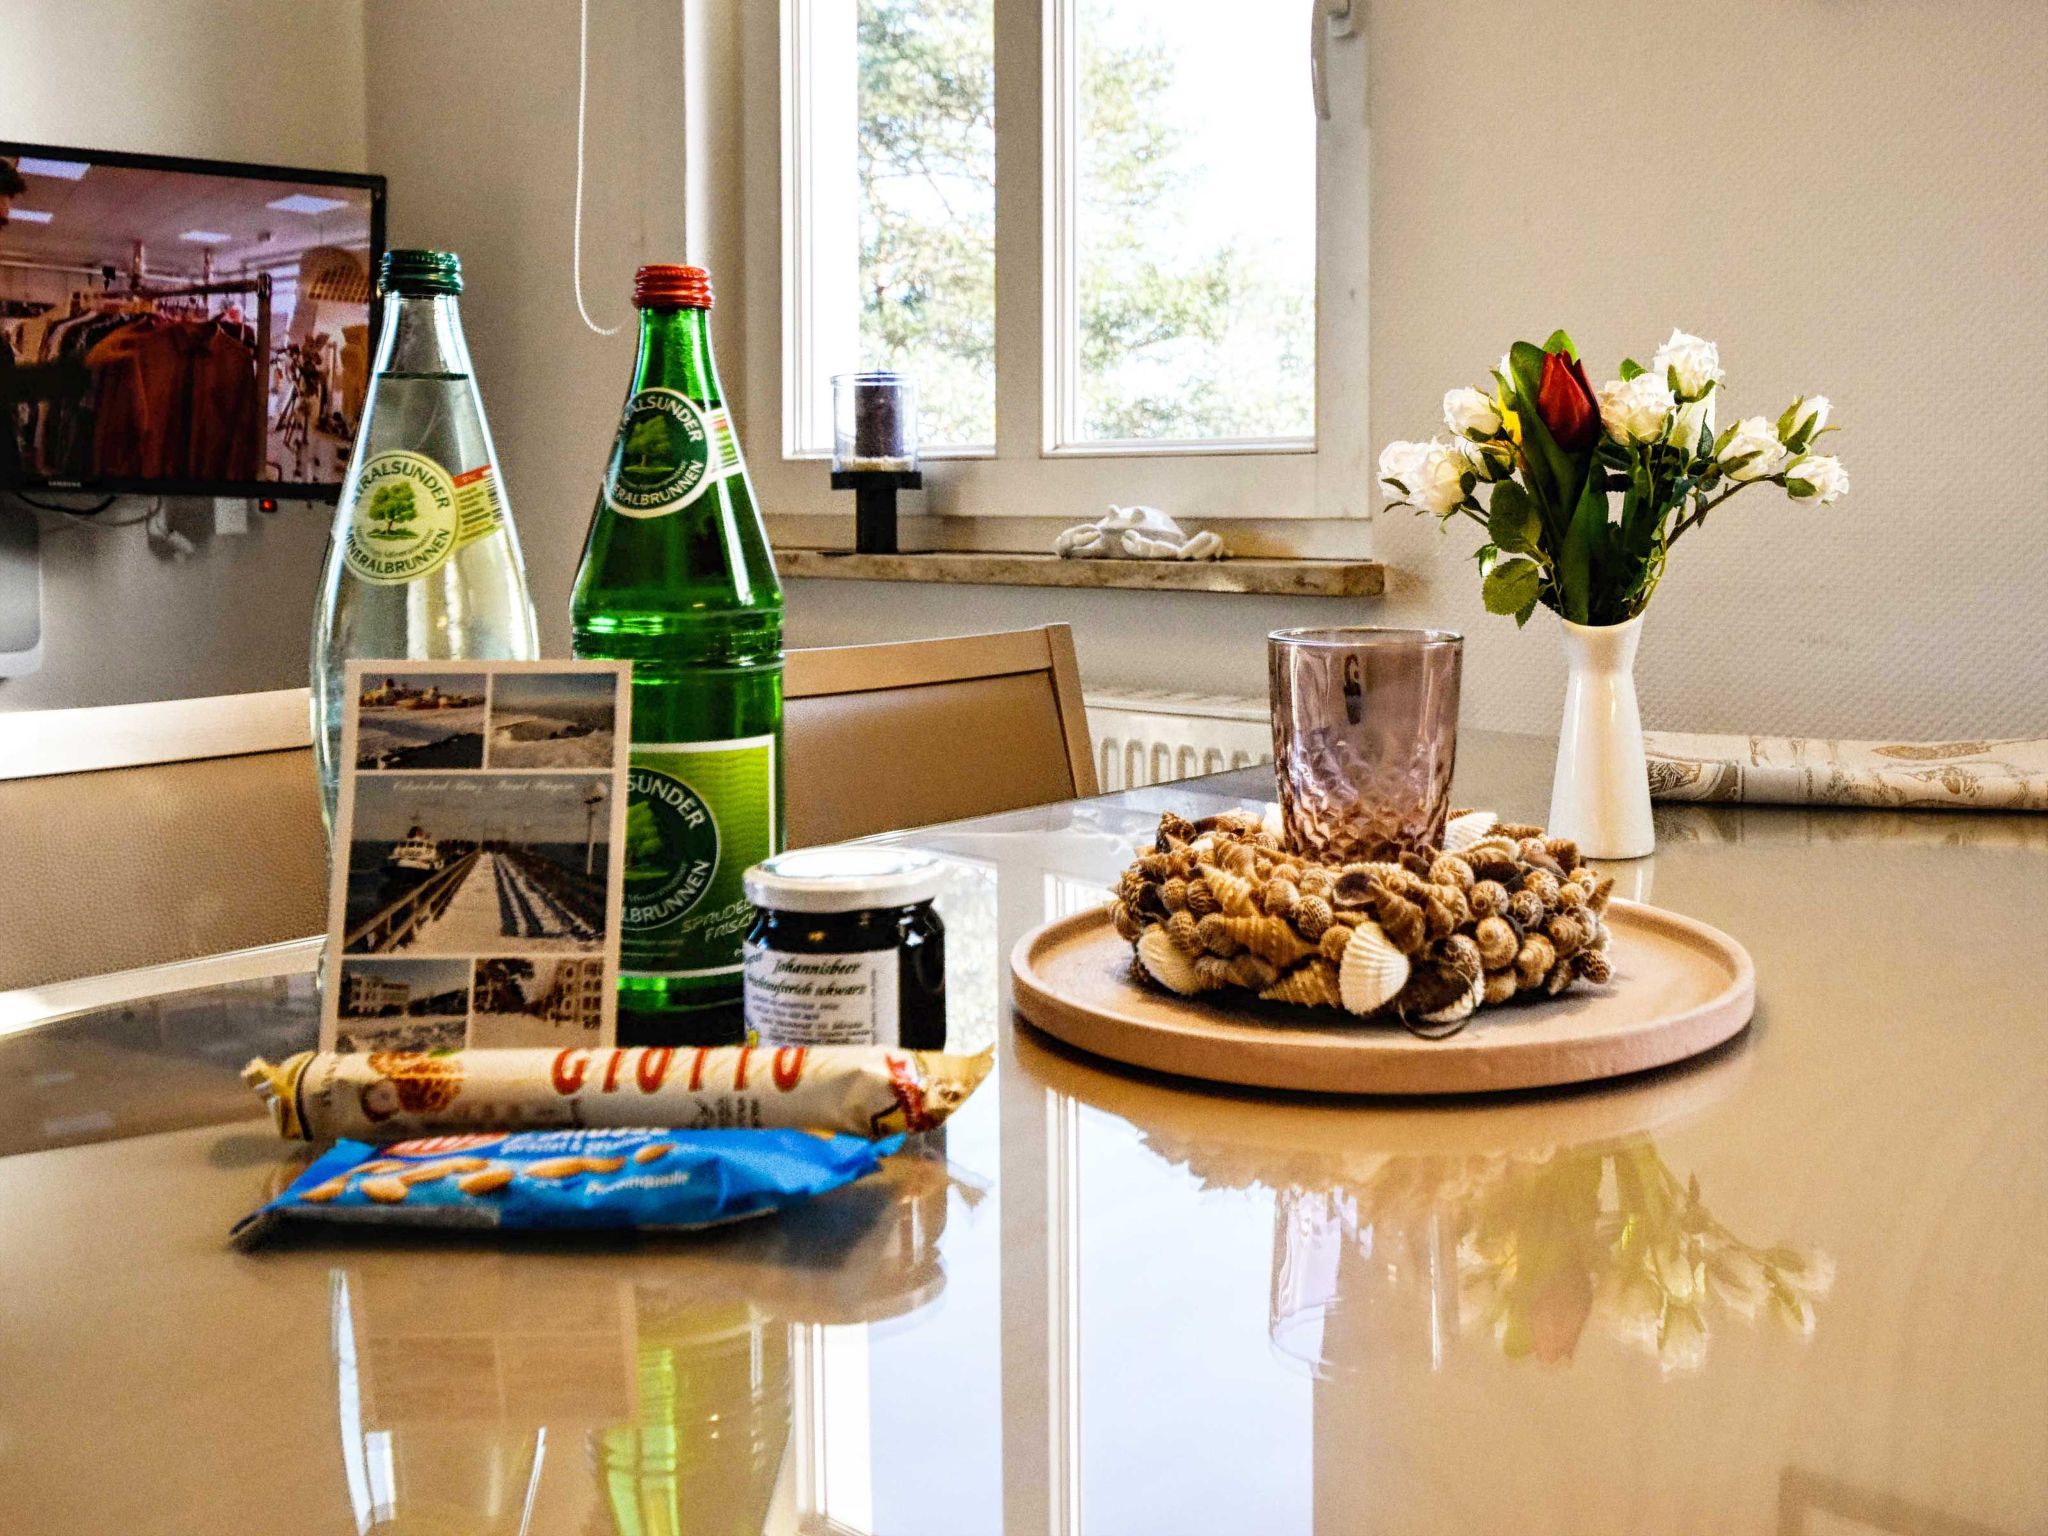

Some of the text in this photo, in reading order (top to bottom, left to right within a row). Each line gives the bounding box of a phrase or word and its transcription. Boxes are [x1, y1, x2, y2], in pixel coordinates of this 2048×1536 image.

[626, 774, 706, 830] SUNDER
[621, 860, 711, 923] LBRUNNEN
[772, 956, 863, 975] Johannisbeer
